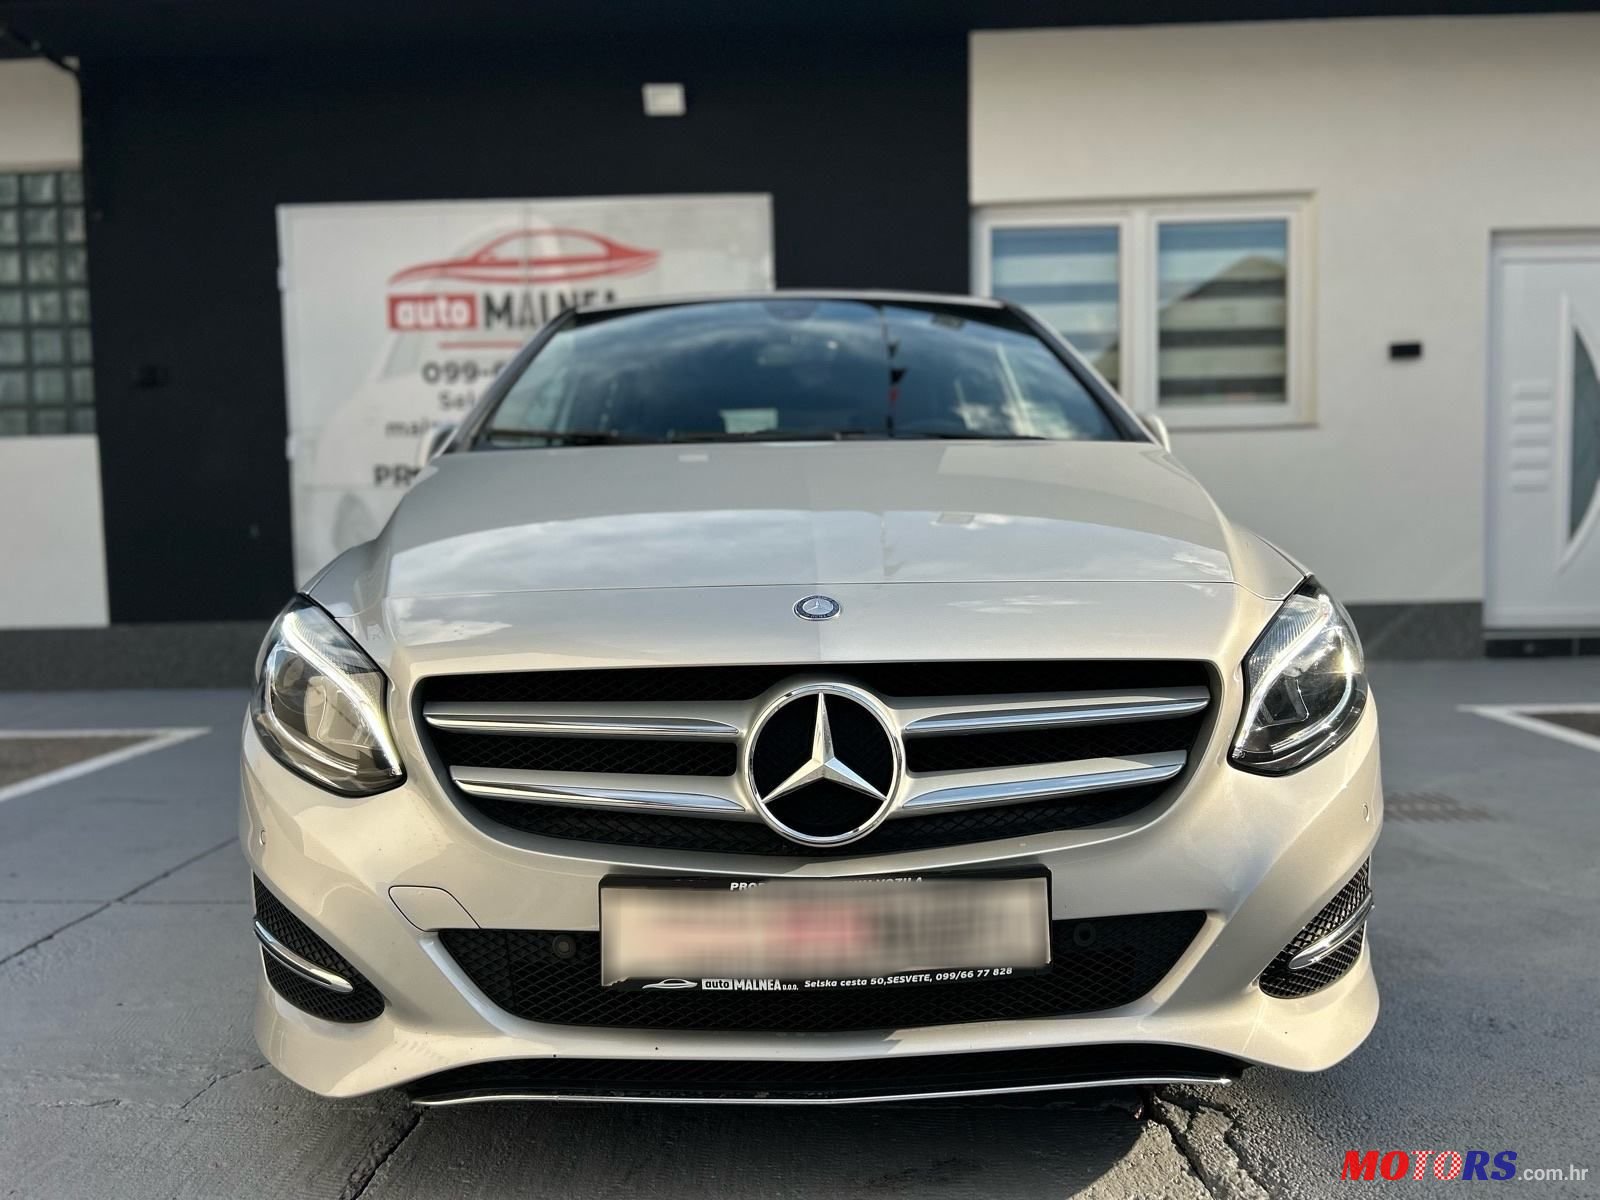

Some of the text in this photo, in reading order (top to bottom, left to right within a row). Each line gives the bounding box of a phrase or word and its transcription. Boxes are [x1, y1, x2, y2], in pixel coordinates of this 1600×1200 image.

[395, 295, 467, 326] auto
[704, 979, 730, 988] auto
[733, 978, 782, 991] MALNEA
[804, 979, 837, 988] Selska
[840, 977, 867, 987] cesta
[935, 970, 974, 982] 099/66
[977, 968, 991, 978] 77
[992, 966, 1013, 976] 828
